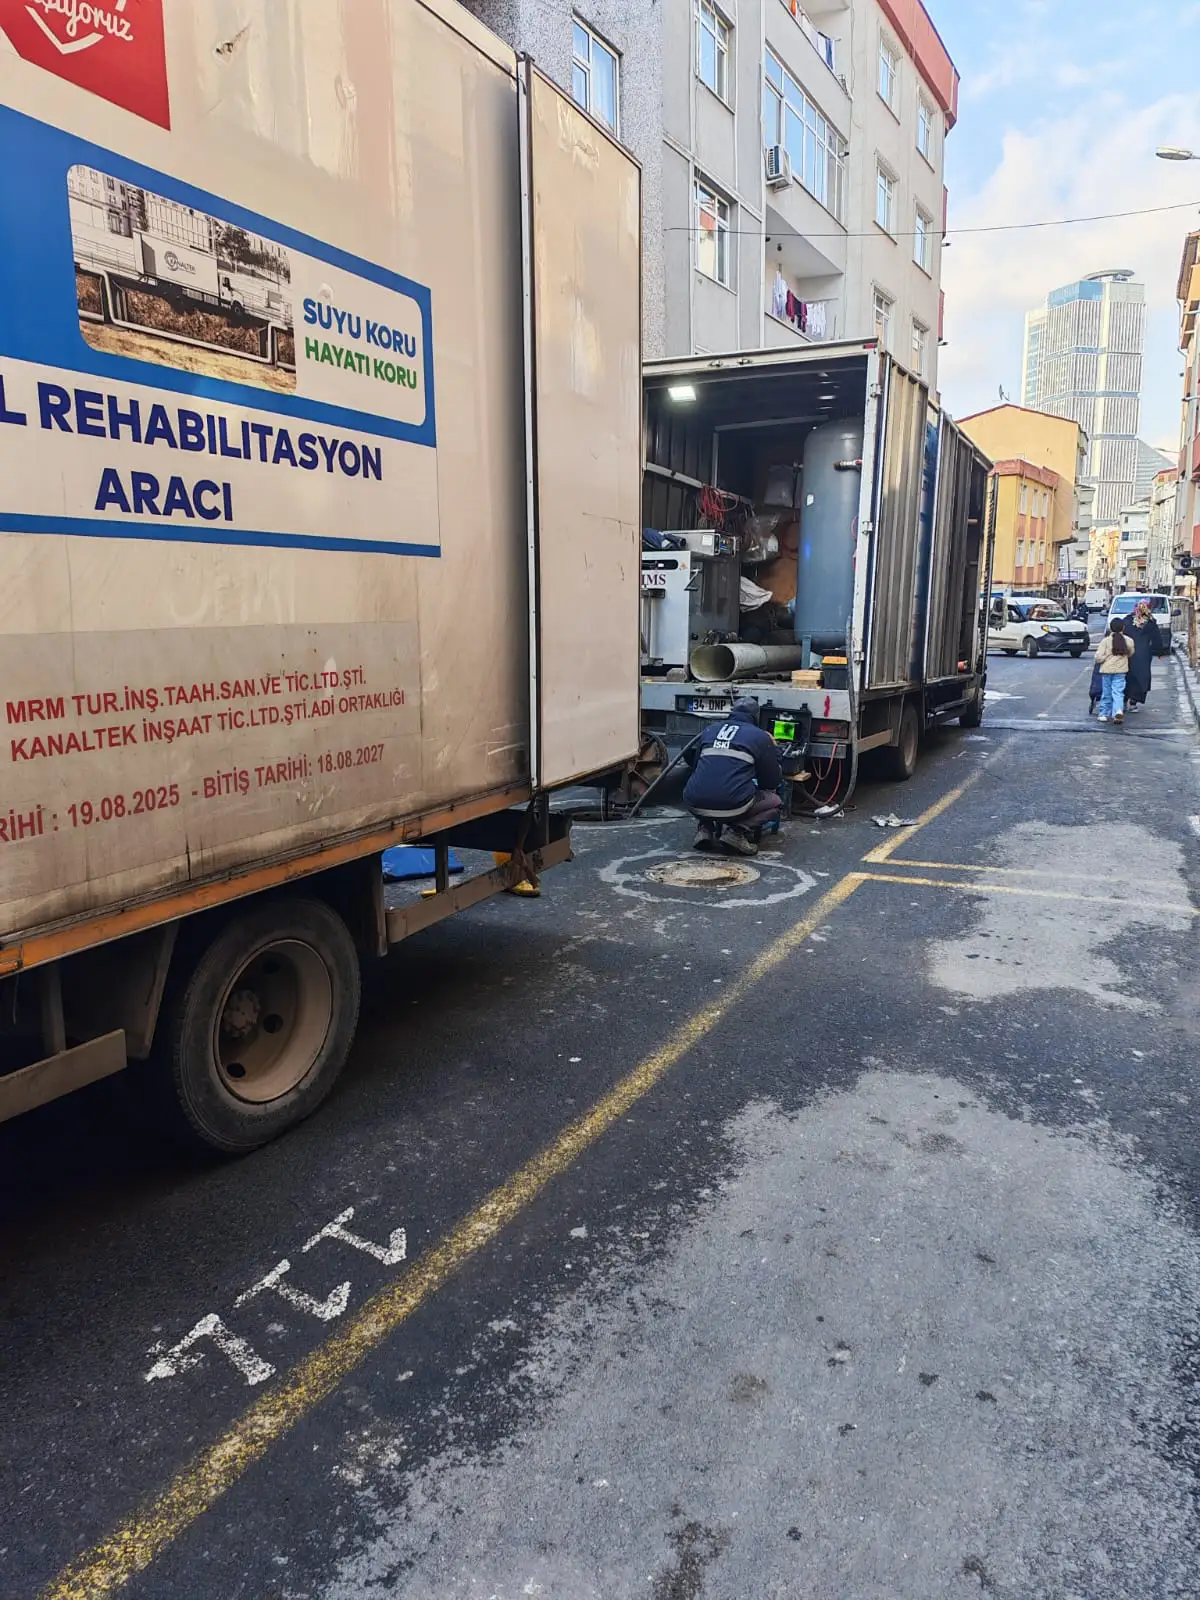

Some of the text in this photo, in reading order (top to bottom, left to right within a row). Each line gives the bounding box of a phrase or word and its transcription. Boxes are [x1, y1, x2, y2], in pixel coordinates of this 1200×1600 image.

[303, 298, 416, 358] SUYU KORU
[305, 336, 418, 389] HAYATI KORU
[37, 381, 382, 481] REHABILITASYON
[95, 468, 233, 521] ARACI
[6, 697, 65, 724] MRM
[285, 665, 366, 693] TİC.LTD.ŞTİ.
[693, 697, 705, 711] 34
[708, 697, 726, 711] DNP
[11, 688, 405, 761] KANALTEK İNŞAAT TİC.LTD.ŞTİ.ADİ ORTAKLIĞI
[67, 784, 180, 828] 19.08.2025
[203, 766, 250, 799] BİTİŞ
[254, 754, 313, 788] TARİHİ:
[317, 743, 385, 774] 18.08.2027
